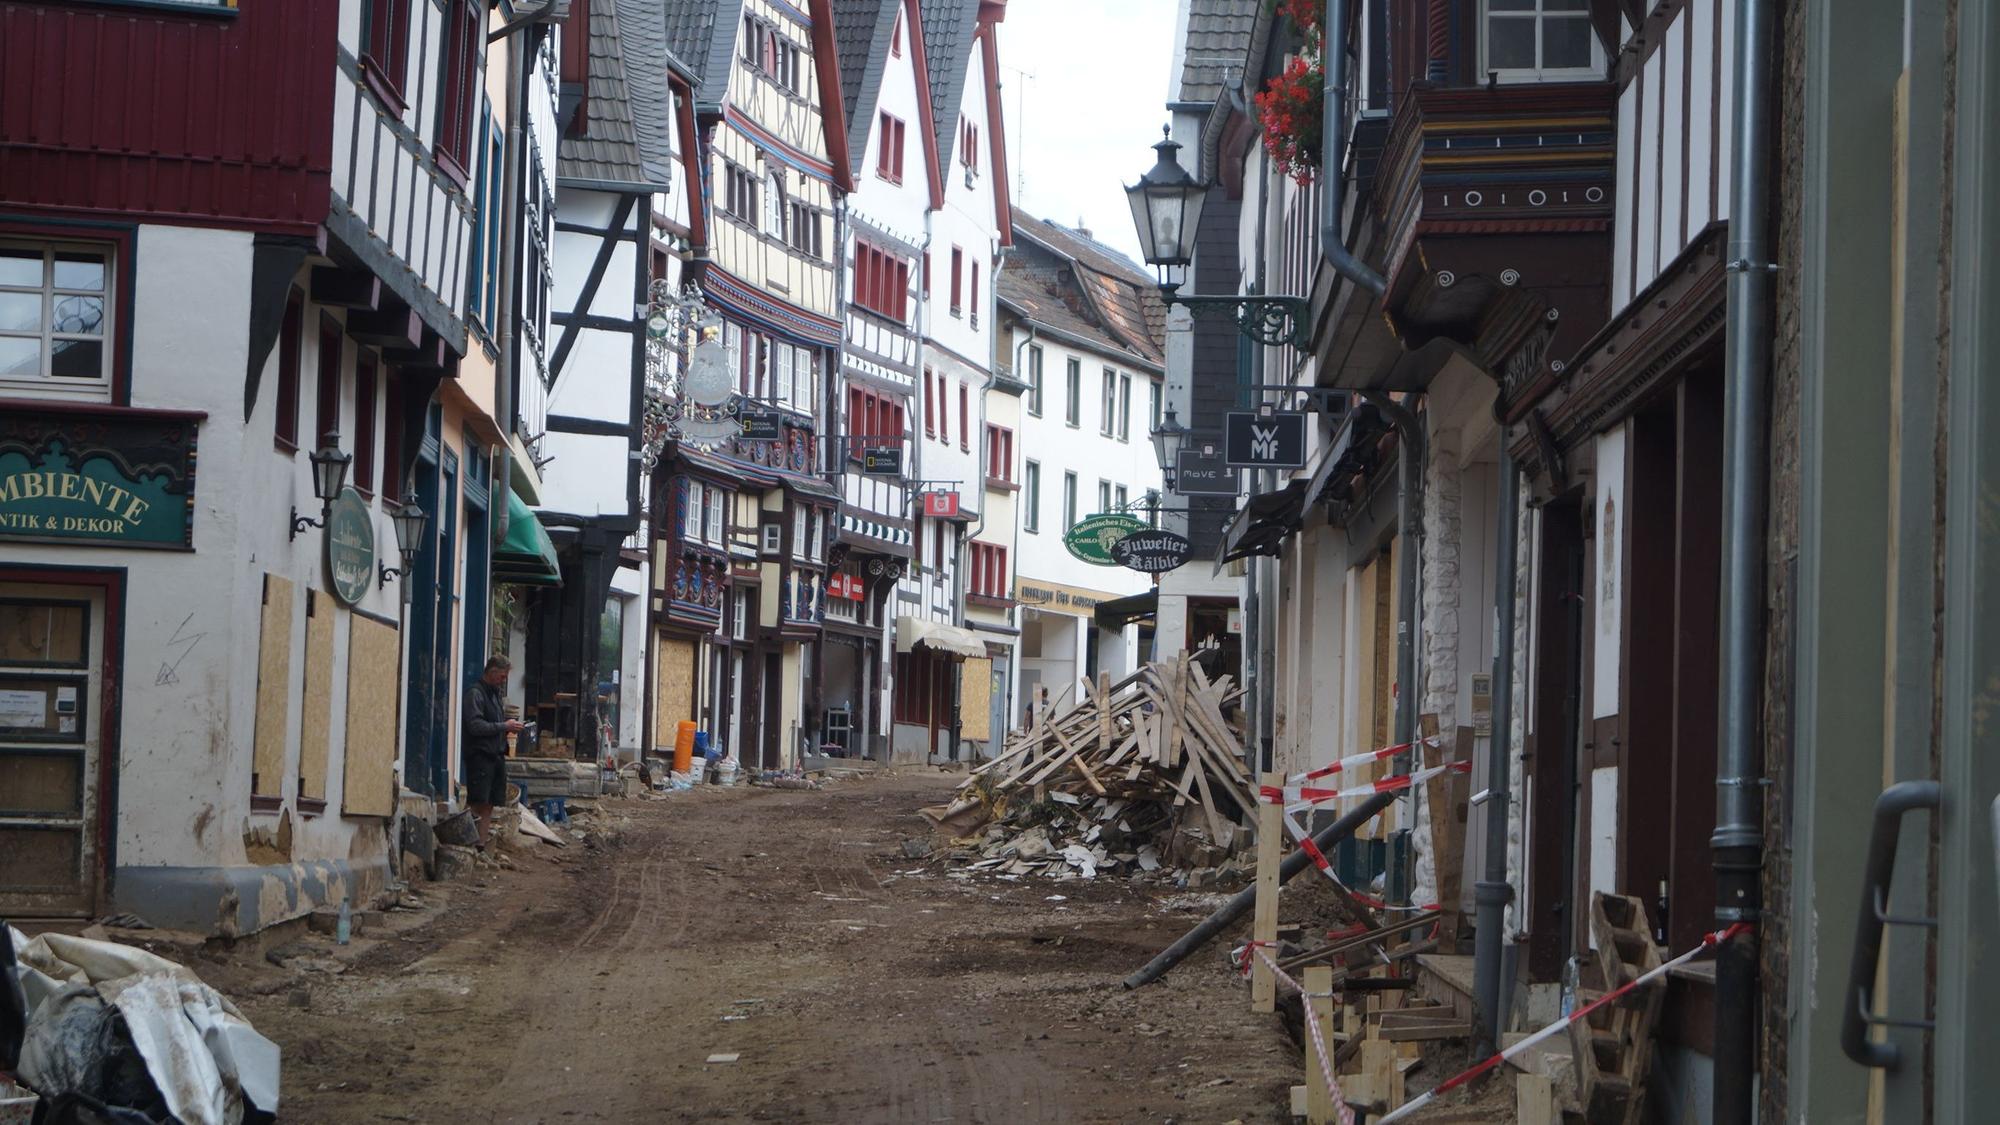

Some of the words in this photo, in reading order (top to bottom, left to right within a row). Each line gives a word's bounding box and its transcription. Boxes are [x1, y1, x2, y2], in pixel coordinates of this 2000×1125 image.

[1251, 425, 1279, 460] WMF
[45, 516, 58, 530] &
[63, 517, 125, 533] DEKOR
[1119, 536, 1188, 557] Juwelier
[1126, 553, 1180, 570] Kälble
